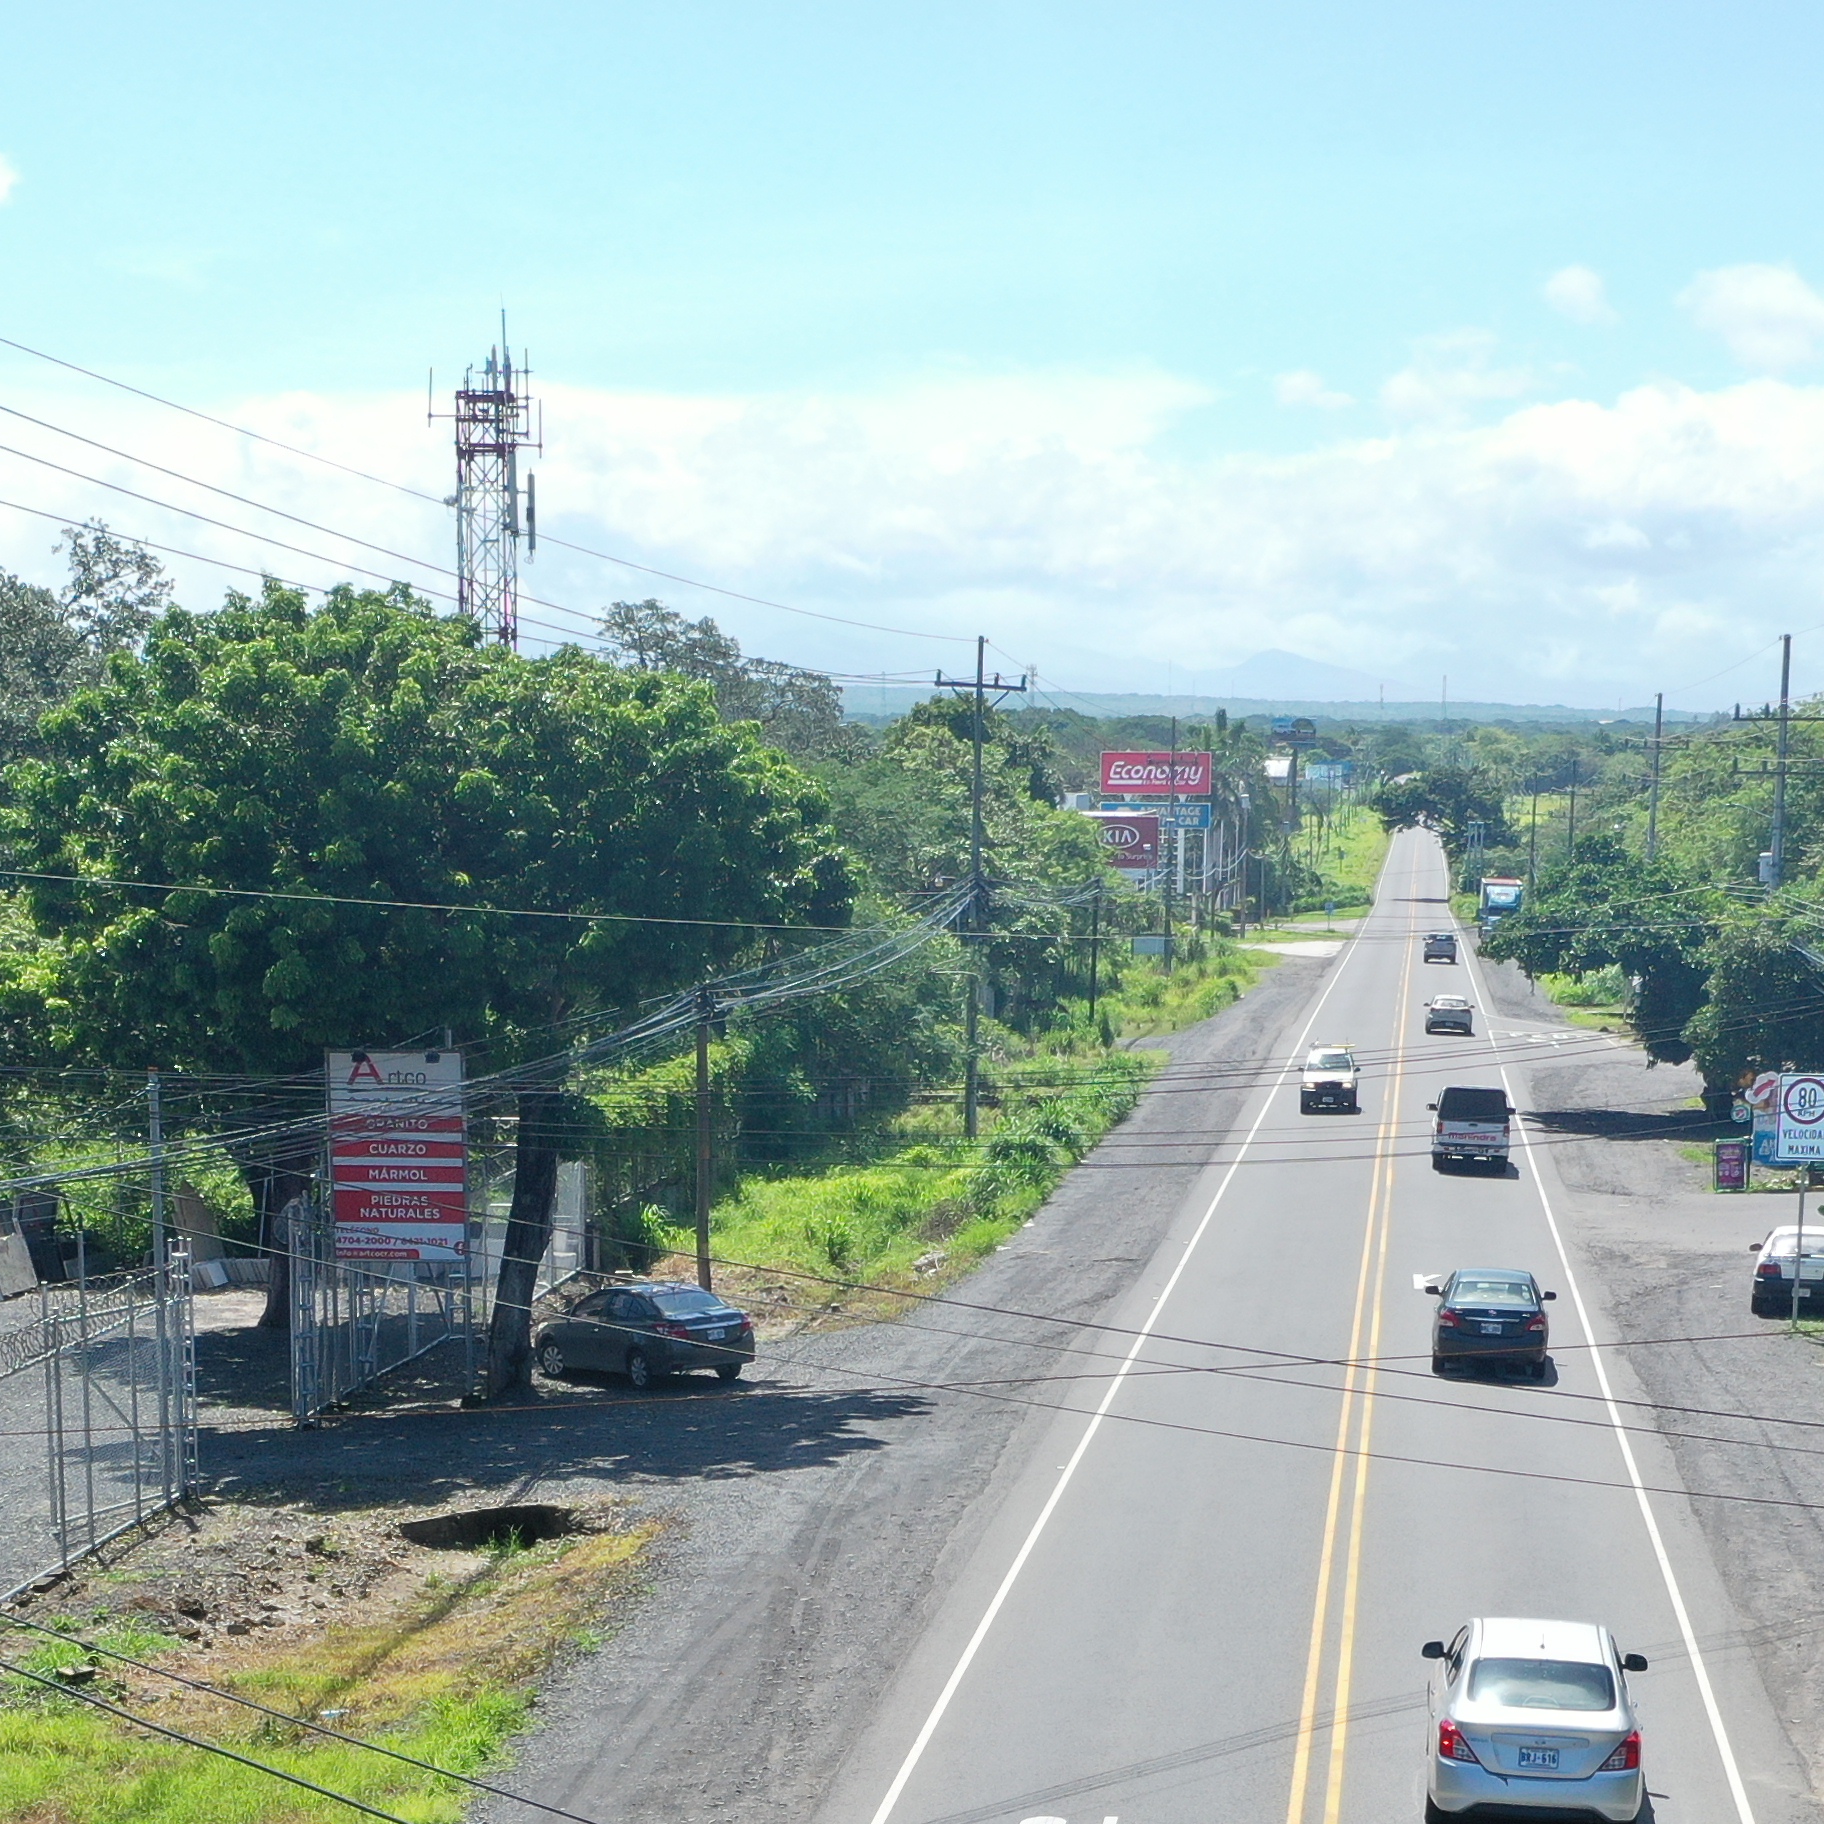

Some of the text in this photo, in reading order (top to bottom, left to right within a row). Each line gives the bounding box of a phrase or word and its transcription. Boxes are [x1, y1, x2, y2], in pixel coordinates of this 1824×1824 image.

[1109, 761, 1203, 785] Economy
[1103, 830, 1132, 843] KIA
[1798, 1088, 1817, 1107] 80
[1448, 1132, 1497, 1142] mahindra
[369, 1144, 426, 1154] CUARZO
[1788, 1145, 1821, 1155] MAXIMA
[368, 1168, 428, 1180] MÁRMOL
[371, 1196, 429, 1206] PIEDRAS
[360, 1208, 440, 1218] NATURALES
[336, 1236, 391, 1245] 4704-2000
